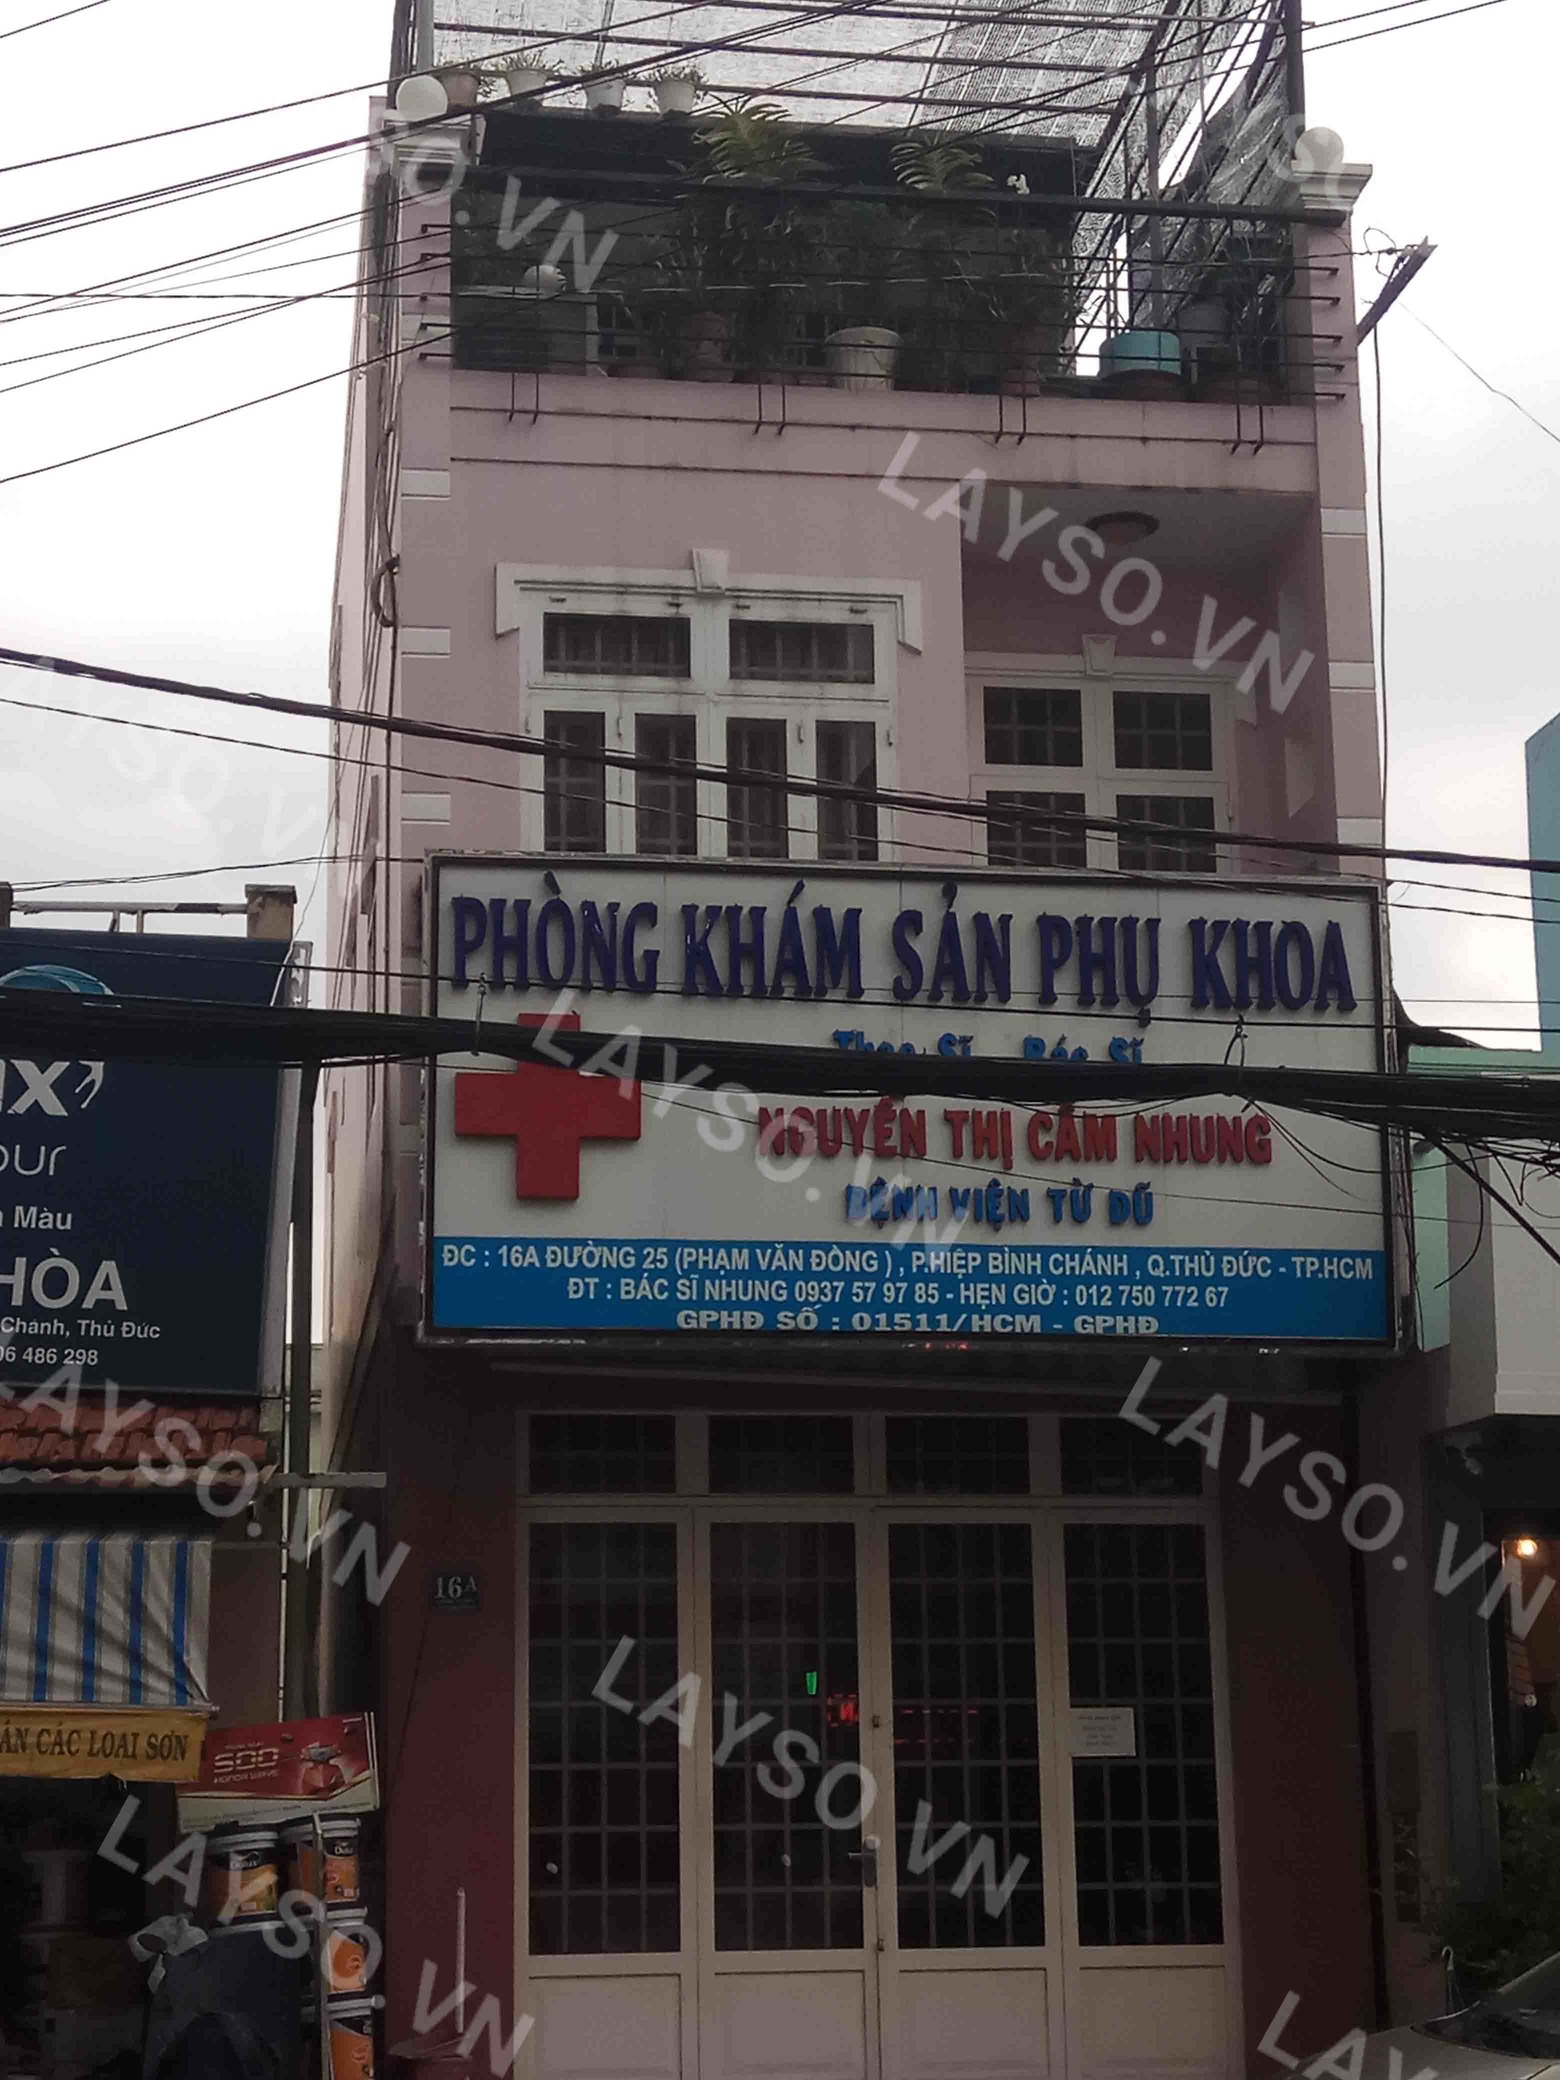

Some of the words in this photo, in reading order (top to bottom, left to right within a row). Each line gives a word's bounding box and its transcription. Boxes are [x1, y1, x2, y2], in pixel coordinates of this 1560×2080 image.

[452, 870, 660, 993] PHÒNG
[682, 879, 865, 998] KHÁM
[892, 881, 1013, 1002] SẢN
[1037, 912, 1161, 1027] PHỤ
[1188, 916, 1357, 1011] KHOA
[945, 1107, 1014, 1170] THỊ
[1134, 1112, 1272, 1165] NHUNG
[14, 1205, 72, 1230] Màu
[846, 1176, 938, 1229] BỆNH
[949, 1177, 1030, 1232] VIỆN
[1047, 1177, 1094, 1223] TỪ
[442, 1244, 476, 1267] ĐC
[498, 1245, 540, 1268] 16A
[545, 1240, 636, 1270] ĐƯỜNG
[643, 1247, 668, 1269] 25
[675, 1247, 749, 1276] (PHẠM
[755, 1244, 802, 1271] VĂN
[912, 1249, 981, 1279] P.HIỆP
[989, 1246, 1041, 1274] BÌNH
[1049, 1248, 1128, 1276] CHÁNH
[1147, 1250, 1215, 1277] Q.THỦ
[1222, 1250, 1272, 1278] ĐỨC
[1292, 1256, 1374, 1280] TP.HCM
[567, 1277, 599, 1300] ĐT
[620, 1273, 668, 1300] BÁC
[676, 1274, 699, 1301] SĨ
[704, 1279, 788, 1302] NHUNG
[794, 1281, 845, 1303] 0937
[852, 1282, 876, 1303] 57
[883, 1282, 908, 1304] 97
[914, 1283, 939, 1304] 85
[960, 1283, 1008, 1310] HẸN
[1013, 1278, 1056, 1306] GIỜ
[1075, 1285, 1112, 1307] 012
[1119, 1285, 1156, 1308] 750
[1162, 1286, 1199, 1308] 772
[1205, 1287, 1229, 1308] 67
[77, 1319, 115, 1338] Thủ
[121, 1321, 161, 1339] Đức
[676, 1310, 765, 1330] GPHĐ
[776, 1304, 822, 1331] SỐ
[852, 1312, 1042, 1333] 01511/HCM
[1074, 1315, 1159, 1335] GPHĐ
[22, 1346, 58, 1364] 486
[63, 1349, 99, 1366] 298
[433, 1575, 478, 1599] 16A
[36, 1721, 81, 1757] CÁC
[145, 1730, 190, 1762] SƠN
